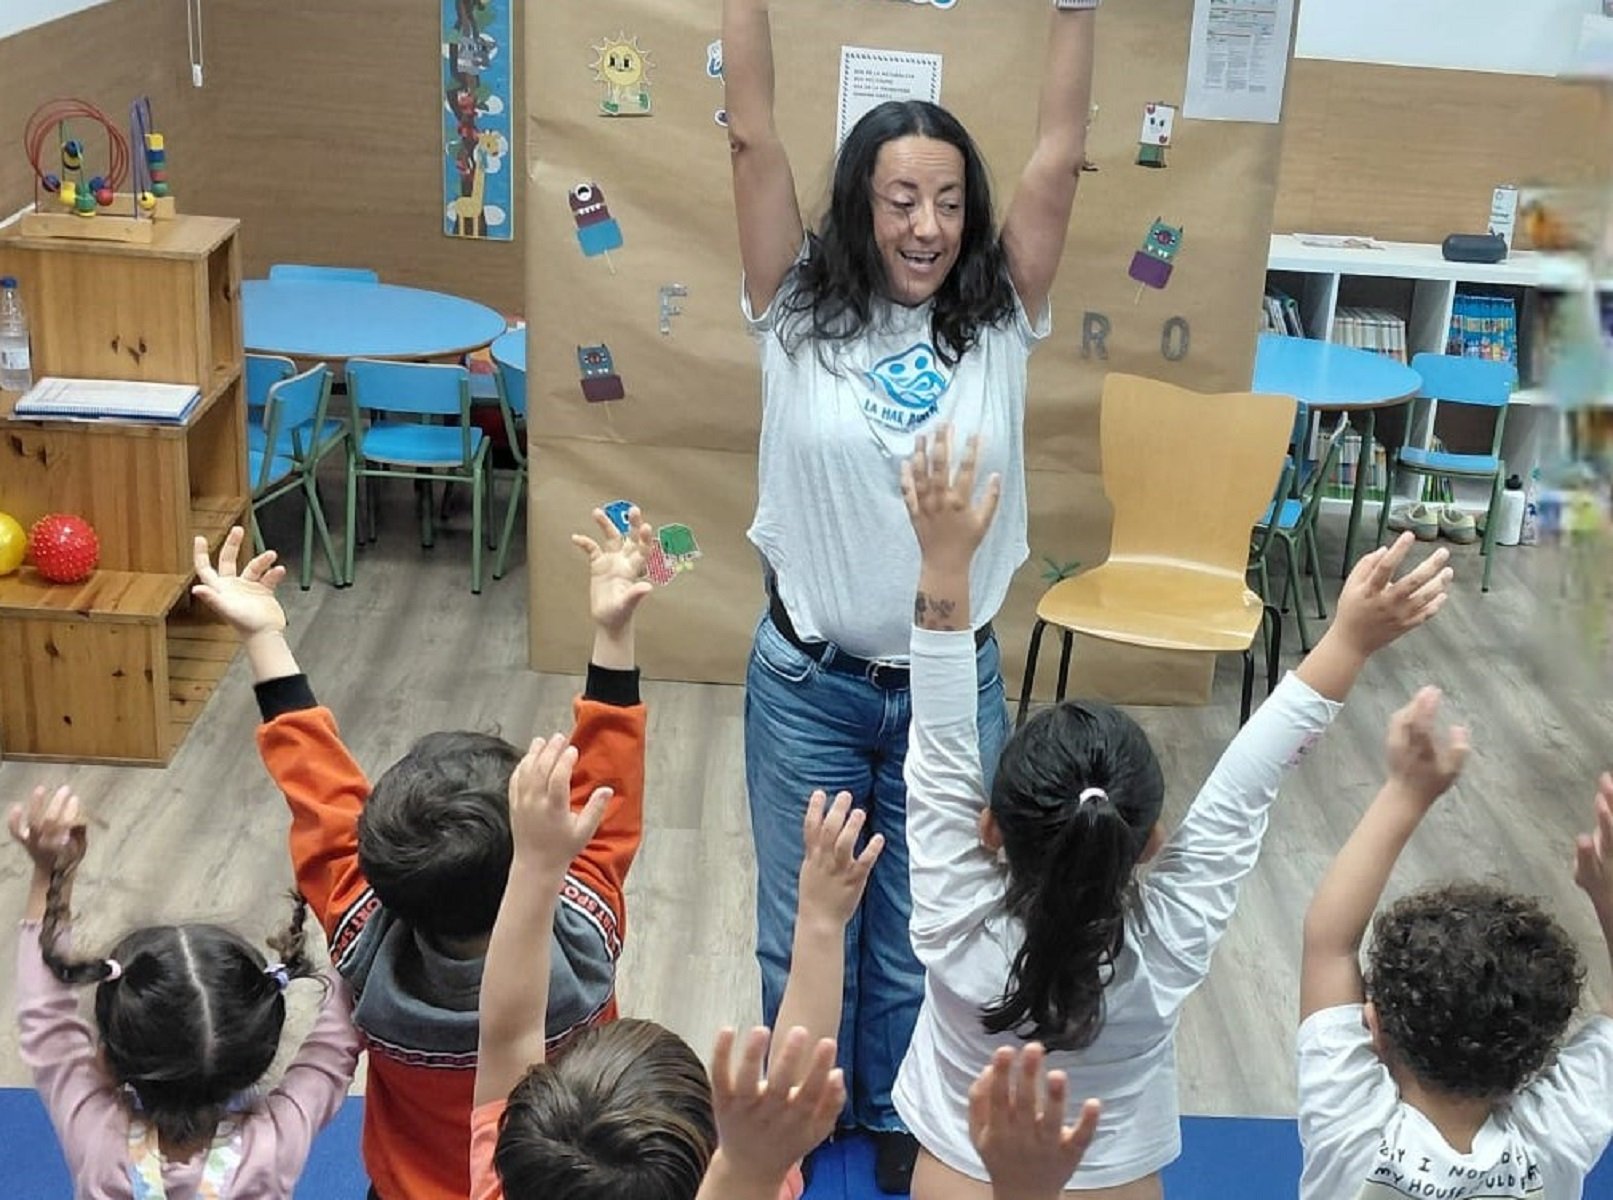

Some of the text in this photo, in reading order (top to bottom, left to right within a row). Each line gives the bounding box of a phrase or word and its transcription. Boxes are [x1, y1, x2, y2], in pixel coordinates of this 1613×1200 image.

[1081, 311, 1109, 361] R
[1418, 1157, 1432, 1173] I
[1374, 1166, 1404, 1185] MY
